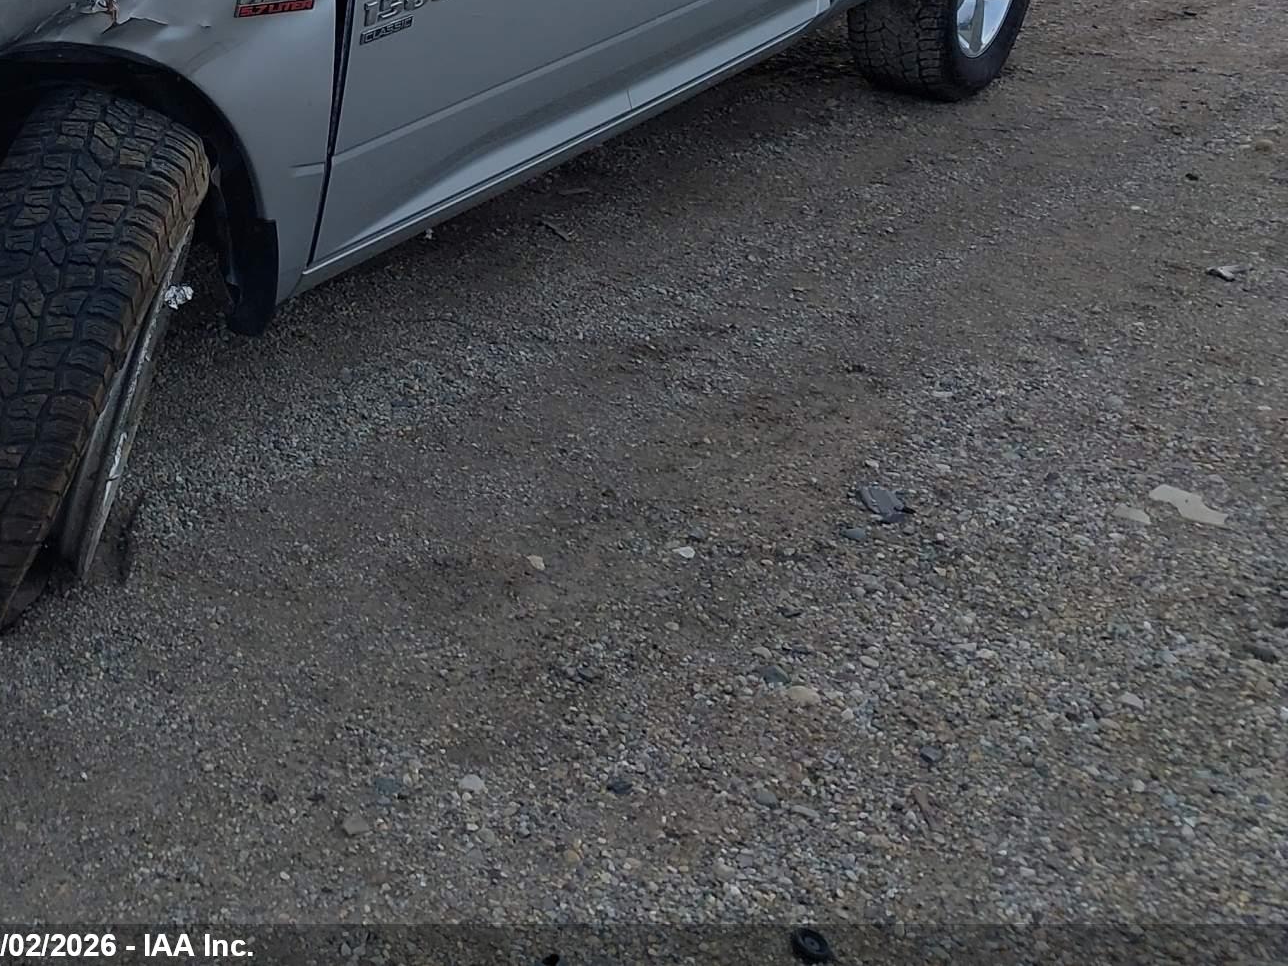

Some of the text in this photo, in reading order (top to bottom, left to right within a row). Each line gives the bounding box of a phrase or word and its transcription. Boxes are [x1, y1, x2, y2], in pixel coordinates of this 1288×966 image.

[239, 0, 314, 17] 5.7 LITER
[363, 16, 413, 43] CLASSIC
